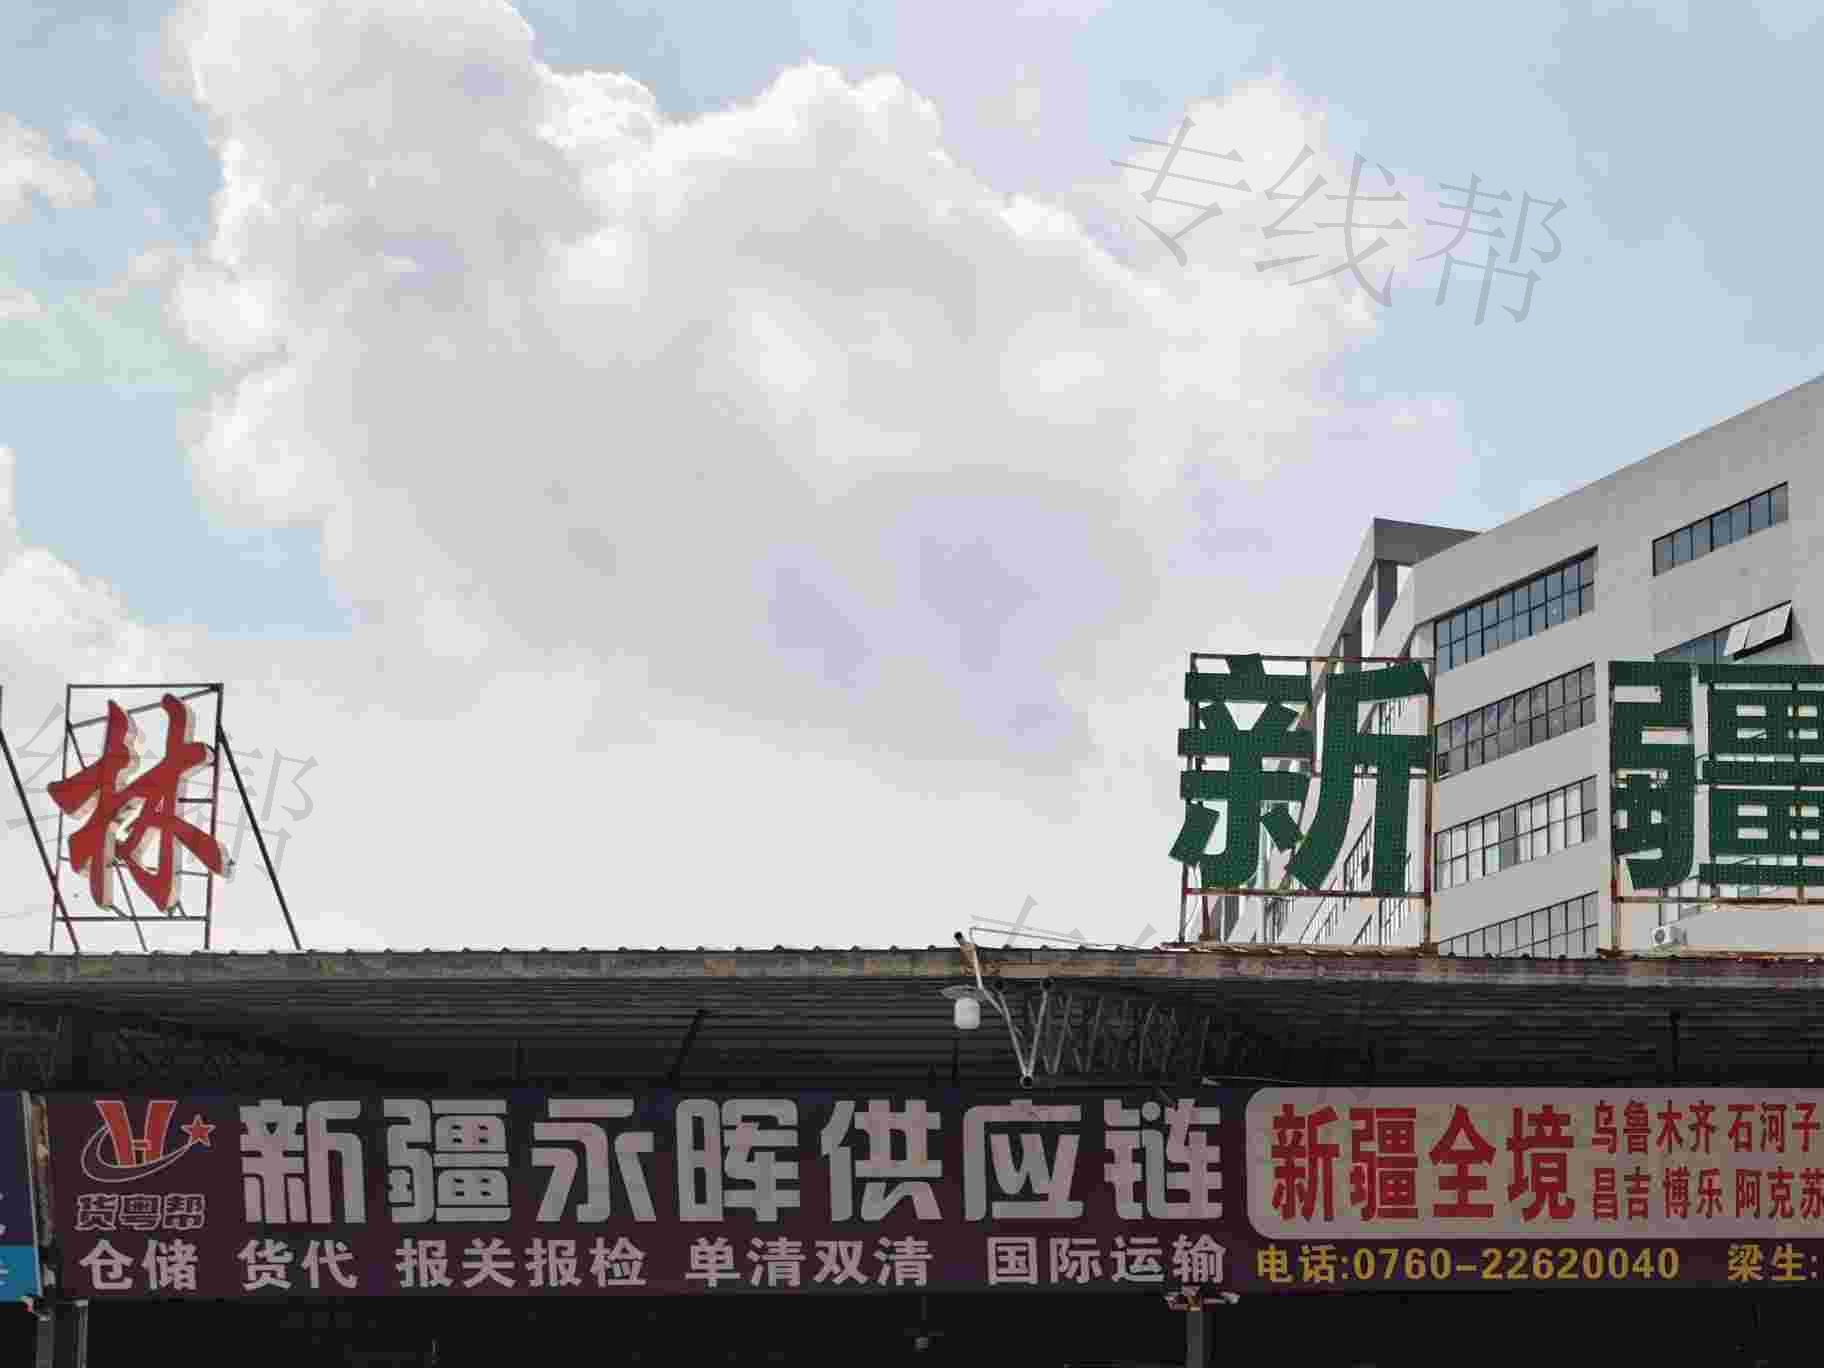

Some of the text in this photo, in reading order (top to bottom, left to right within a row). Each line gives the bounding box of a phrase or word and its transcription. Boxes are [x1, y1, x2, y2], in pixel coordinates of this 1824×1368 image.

[47, 693, 228, 912] 林
[1591, 1101, 1716, 1154] 乌鲁木齐
[1727, 1102, 1821, 1153] 石河子
[239, 1097, 1224, 1223] 新疆永晖供应链
[1270, 1103, 1577, 1222] 新疆全境
[1591, 1167, 1652, 1220] 昌吉
[1663, 1167, 1724, 1220] 博乐
[79, 1234, 1227, 1291] 仓储 货代 报关报检 单清双清 国际运输
[1256, 1243, 1680, 1284] 电话:0760-22620040
